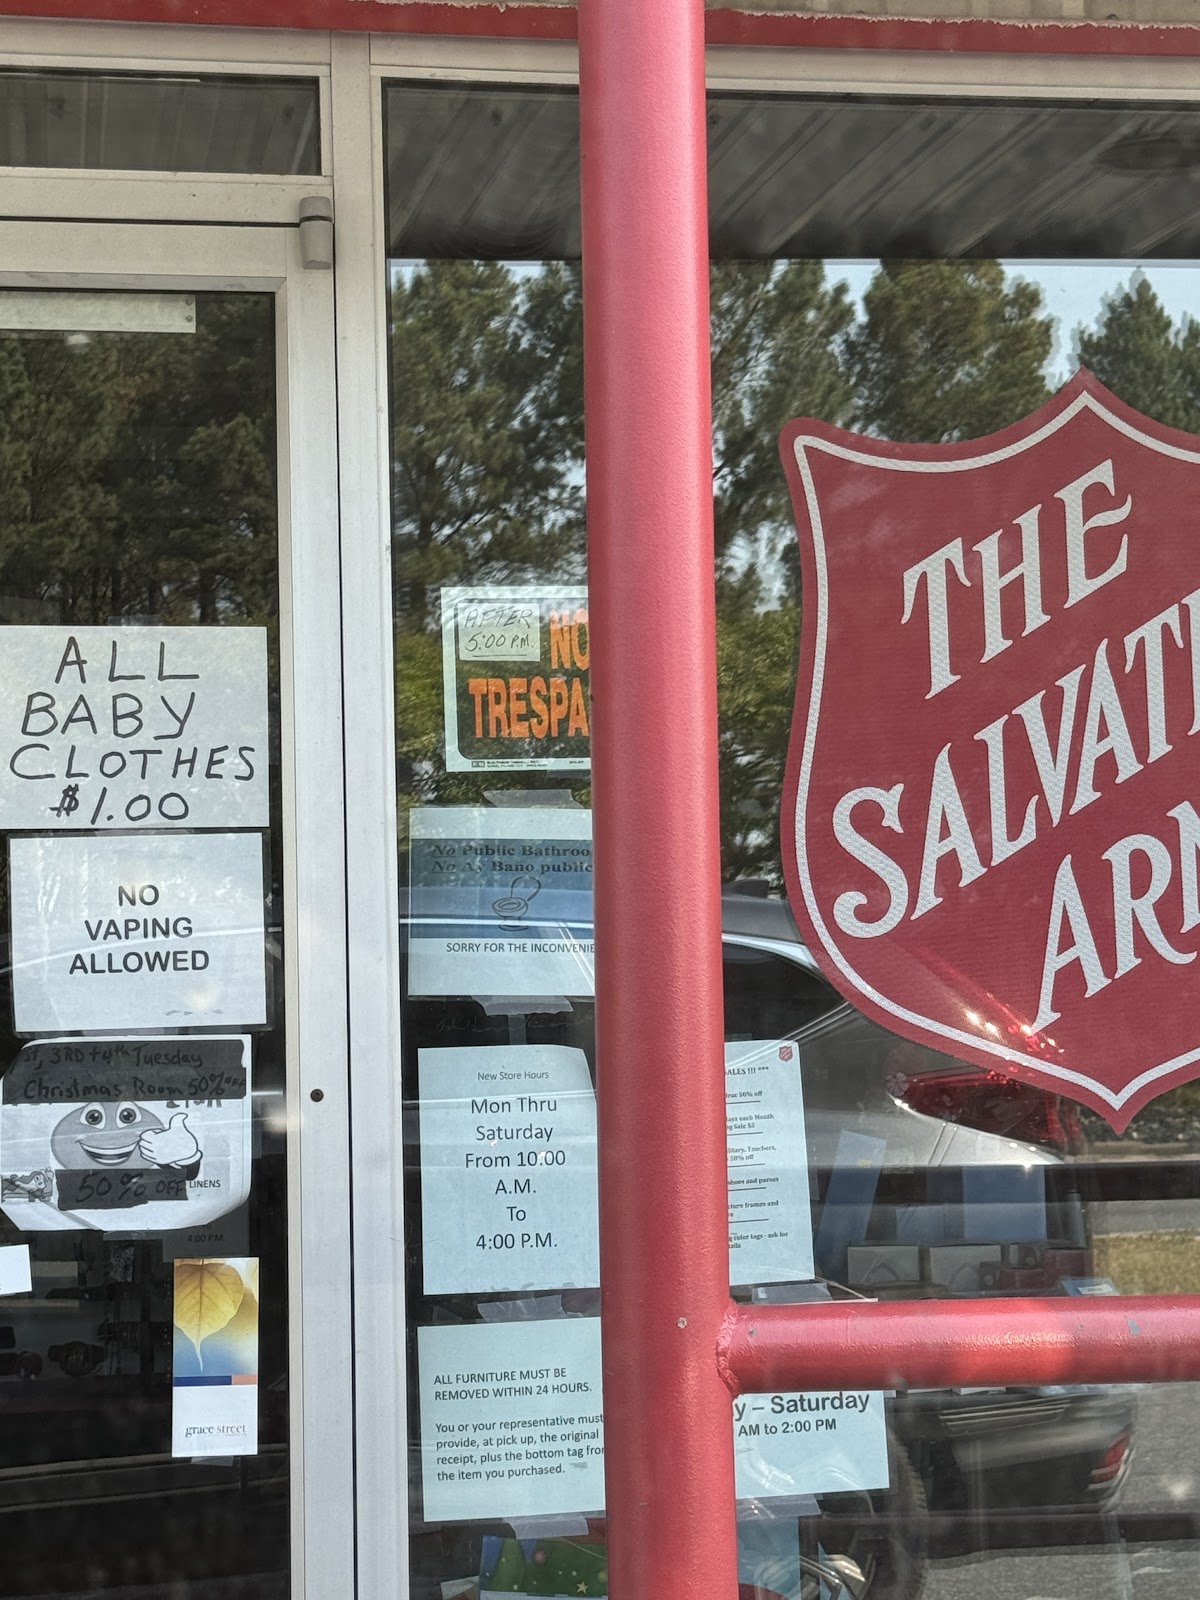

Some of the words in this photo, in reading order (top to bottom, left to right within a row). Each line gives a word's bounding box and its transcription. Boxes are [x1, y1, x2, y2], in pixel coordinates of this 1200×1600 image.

[901, 459, 1133, 700] THE
[464, 607, 533, 629] AFTER
[464, 631, 507, 652] 5:00
[549, 608, 590, 671] NO
[55, 636, 200, 684] ALL
[21, 691, 196, 741] BABY
[468, 675, 590, 739] TRESPA
[9, 743, 255, 781] CLOTHES
[49, 784, 189, 825] $1.00
[431, 844, 457, 858] No
[462, 845, 515, 857] Public
[521, 844, 593, 857] Bathroo
[431, 861, 457, 874] No
[118, 884, 160, 906] NO
[84, 917, 193, 941] VAPING
[446, 942, 481, 953] SORRY
[484, 942, 505, 953] FOR
[508, 942, 528, 953] THE
[69, 950, 209, 975] ALLOWED
[132, 1042, 203, 1068] Tuesday
[477, 1072, 498, 1081] New
[499, 1070, 521, 1080] Store
[524, 1070, 549, 1080] Hours
[725, 1067, 746, 1076] ALES
[23, 1079, 122, 1099] Christmas
[131, 1076, 183, 1096] Room
[471, 1098, 511, 1114] Mon
[516, 1096, 557, 1113] Thru
[754, 1113, 775, 1121] Month
[475, 1122, 553, 1142] Saturday
[465, 1152, 510, 1169] From
[516, 1150, 566, 1168] 10:00
[189, 1178, 221, 1189] LINENS
[495, 1178, 537, 1195] A.M.
[506, 1206, 527, 1222] To
[475, 1233, 515, 1250] 4:00
[520, 1231, 558, 1249] P.M.
[434, 1374, 453, 1385] ALL
[455, 1370, 517, 1384] FURNITURE
[519, 1368, 551, 1381] MUST
[553, 1367, 567, 1379] BE
[434, 1388, 490, 1401] REMOVED
[492, 1385, 533, 1398] WITHIN
[536, 1384, 549, 1396] 24
[552, 1382, 592, 1394] HOURS.
[770, 1391, 870, 1414] Saturday
[185, 1426, 214, 1438] grace
[216, 1424, 246, 1433] street
[435, 1422, 455, 1434] You
[458, 1423, 470, 1433] or
[472, 1421, 496, 1434] your
[499, 1415, 575, 1431] representative
[738, 1424, 760, 1437] AM
[764, 1422, 778, 1434] to
[781, 1420, 811, 1433] 2:00
[815, 1418, 837, 1431] PM
[436, 1438, 479, 1452] provide,
[482, 1437, 494, 1447] at
[496, 1435, 517, 1448] pick
[520, 1434, 537, 1446] up,
[540, 1432, 557, 1443] the
[560, 1428, 599, 1443] original
[437, 1453, 477, 1466] receipt,
[480, 1452, 502, 1465] plus
[505, 1450, 522, 1461] the
[525, 1448, 564, 1460] bottom
[567, 1446, 584, 1459] tag
[437, 1471, 455, 1482] the
[458, 1469, 482, 1480] item
[485, 1469, 504, 1481] you
[507, 1463, 565, 1479] purchased.
